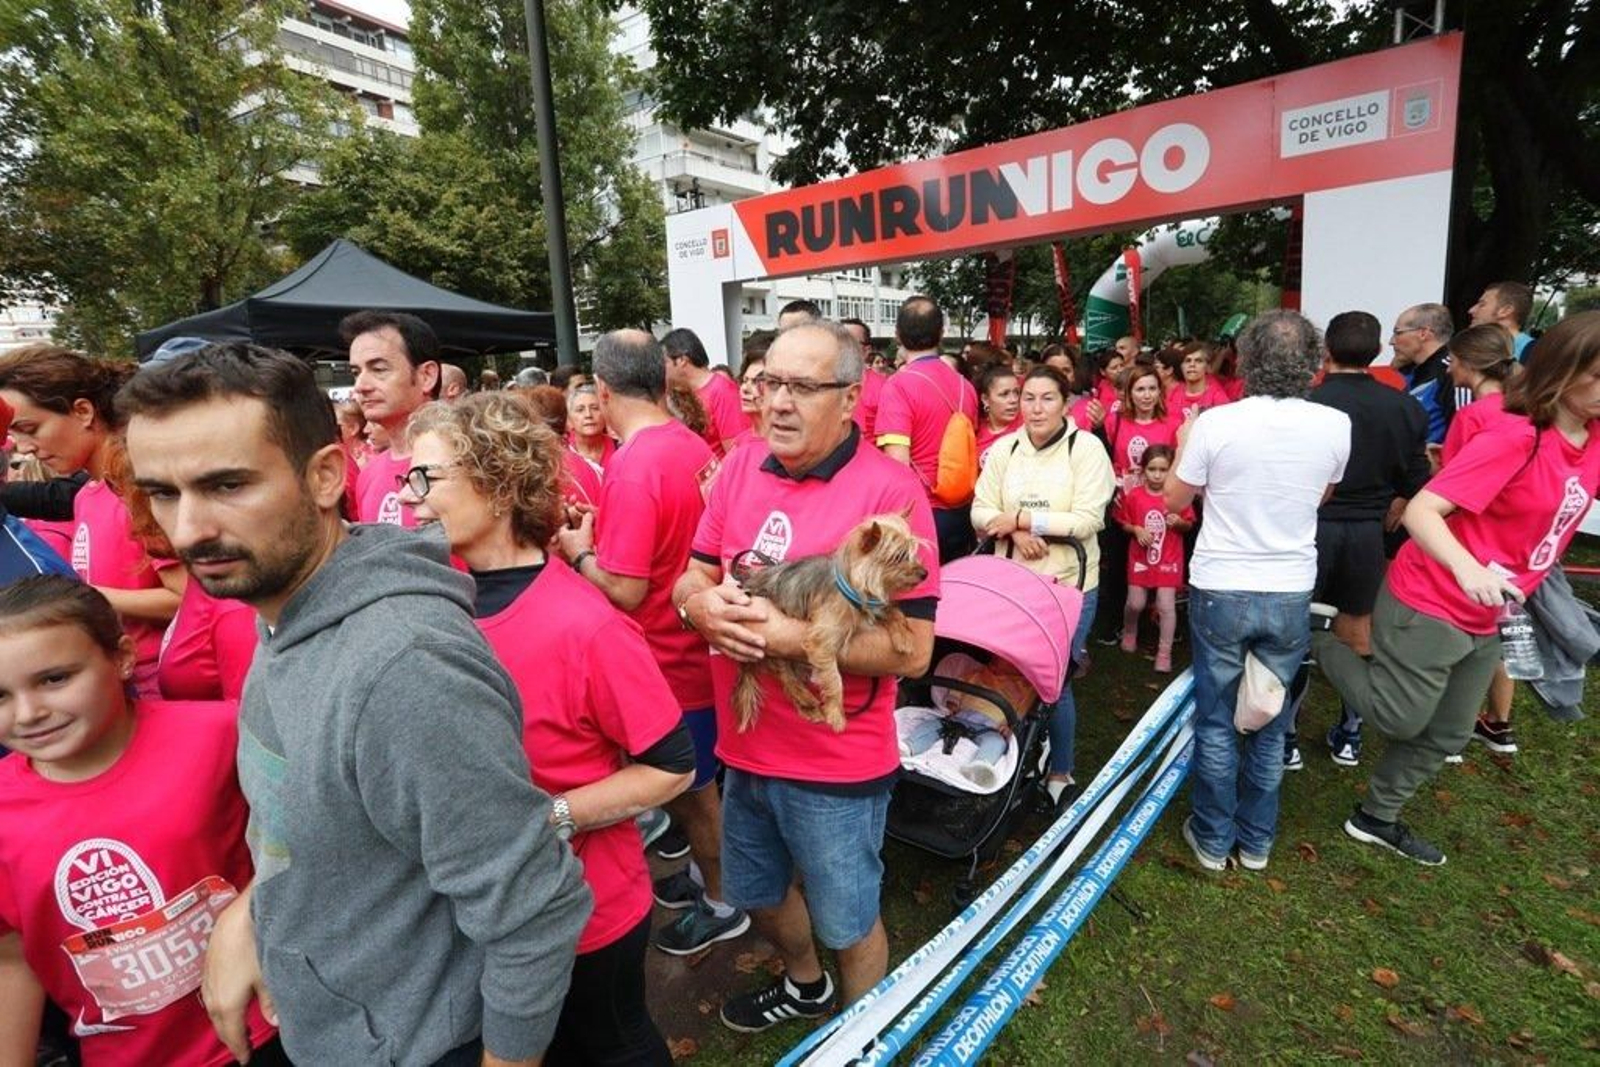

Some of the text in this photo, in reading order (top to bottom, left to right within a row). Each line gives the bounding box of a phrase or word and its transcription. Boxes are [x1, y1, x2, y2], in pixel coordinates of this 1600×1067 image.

[1288, 102, 1380, 131] CONCELLO
[1299, 121, 1368, 144] DE VIGO
[675, 238, 708, 250] CONCELLO
[679, 248, 705, 258] DE VIGO
[73, 849, 113, 875] VI
[1096, 837, 1131, 879] DECATHLON
[71, 872, 139, 903] VIGO
[76, 886, 149, 913] CONTRA EL
[1061, 879, 1099, 930] DECATHLON
[1010, 929, 1061, 990] DECATHLON
[953, 988, 1013, 1064] DECATHLON
